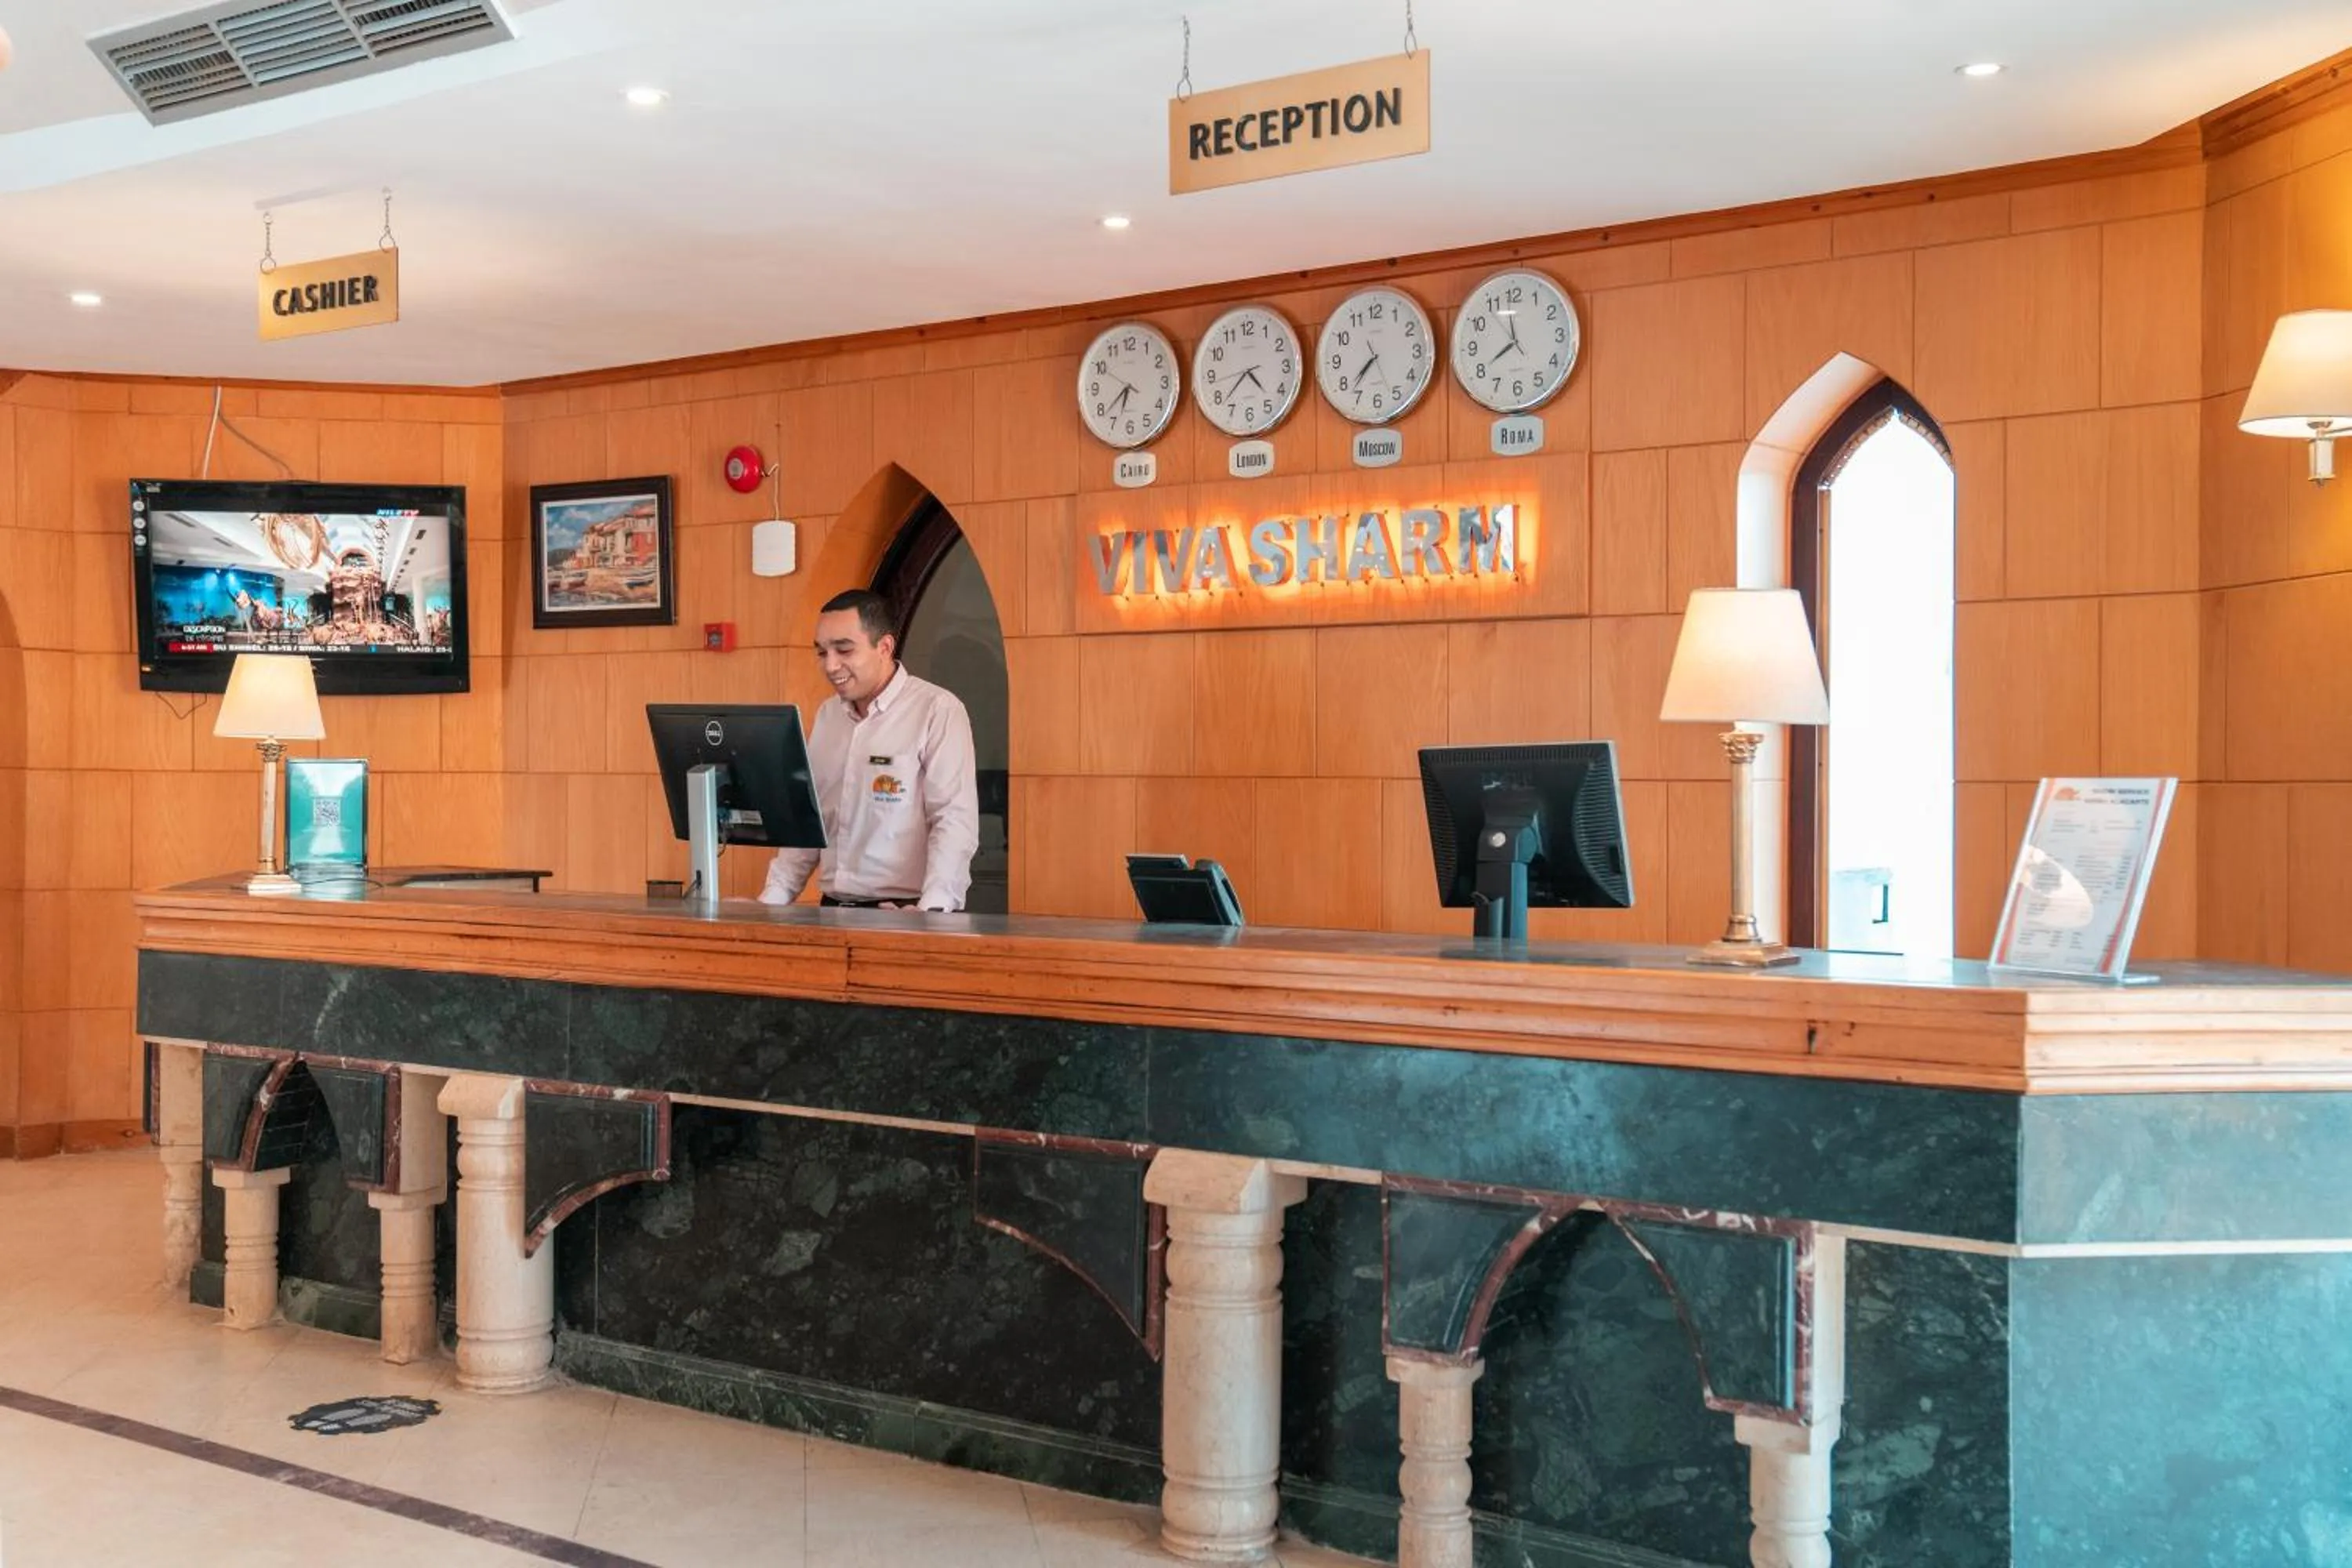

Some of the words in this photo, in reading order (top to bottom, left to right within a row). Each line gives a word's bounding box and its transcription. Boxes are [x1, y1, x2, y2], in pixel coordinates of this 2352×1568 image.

[1189, 87, 1403, 161] RECEPTION
[272, 274, 379, 317] CASHIER
[1505, 289, 1522, 303] 12
[1532, 292, 1538, 306] 1
[1486, 296, 1500, 311] 11
[1369, 304, 1382, 319] 12
[1392, 307, 1398, 322] 1
[1547, 305, 1556, 321] 2
[1350, 314, 1363, 328] 11
[1472, 317, 1486, 331] 10
[1241, 321, 1254, 336] 12
[1262, 325, 1268, 338] 1
[1405, 322, 1414, 337] 2
[1555, 328, 1565, 343] 3
[1224, 329, 1236, 343] 11
[1338, 332, 1349, 346] 10
[1108, 344, 1119, 357] 11
[1123, 337, 1135, 350] 12
[1144, 342, 1149, 354] 1
[1276, 339, 1283, 352] 2
[1468, 342, 1477, 356] 9
[1213, 347, 1224, 361] 10
[1412, 344, 1421, 359] 3
[1155, 355, 1163, 368] 2
[1282, 359, 1290, 373] 3
[1332, 354, 1341, 369] 9
[1549, 354, 1558, 368] 4
[1096, 362, 1106, 375] 10
[1406, 368, 1415, 381] 4
[1476, 364, 1486, 379] 8
[1160, 376, 1169, 389] 3
[1207, 370, 1215, 383] 9
[1340, 376, 1348, 391] 8
[1534, 372, 1544, 387] 5
[1091, 383, 1099, 396] 9
[1277, 382, 1285, 395] 4
[1493, 378, 1501, 392] 7
[1512, 380, 1523, 397] 6
[1215, 390, 1222, 405] 8
[1354, 390, 1363, 405] 7
[1392, 386, 1402, 401] 5
[1155, 398, 1163, 411] 4
[1264, 399, 1272, 413] 5
[1373, 394, 1382, 408] 6
[1098, 403, 1105, 416] 8
[1229, 404, 1236, 417] 7
[1245, 408, 1254, 422] 6
[1110, 417, 1117, 430] 7
[1126, 420, 1134, 434] 6
[1143, 414, 1151, 427] 5
[1501, 428, 1534, 445] ROMA
[1359, 441, 1396, 457] MOSCOW
[1236, 452, 1267, 468] LONDON
[1086, 525, 1234, 596] VIVA
[1248, 503, 1516, 588] SHARM
